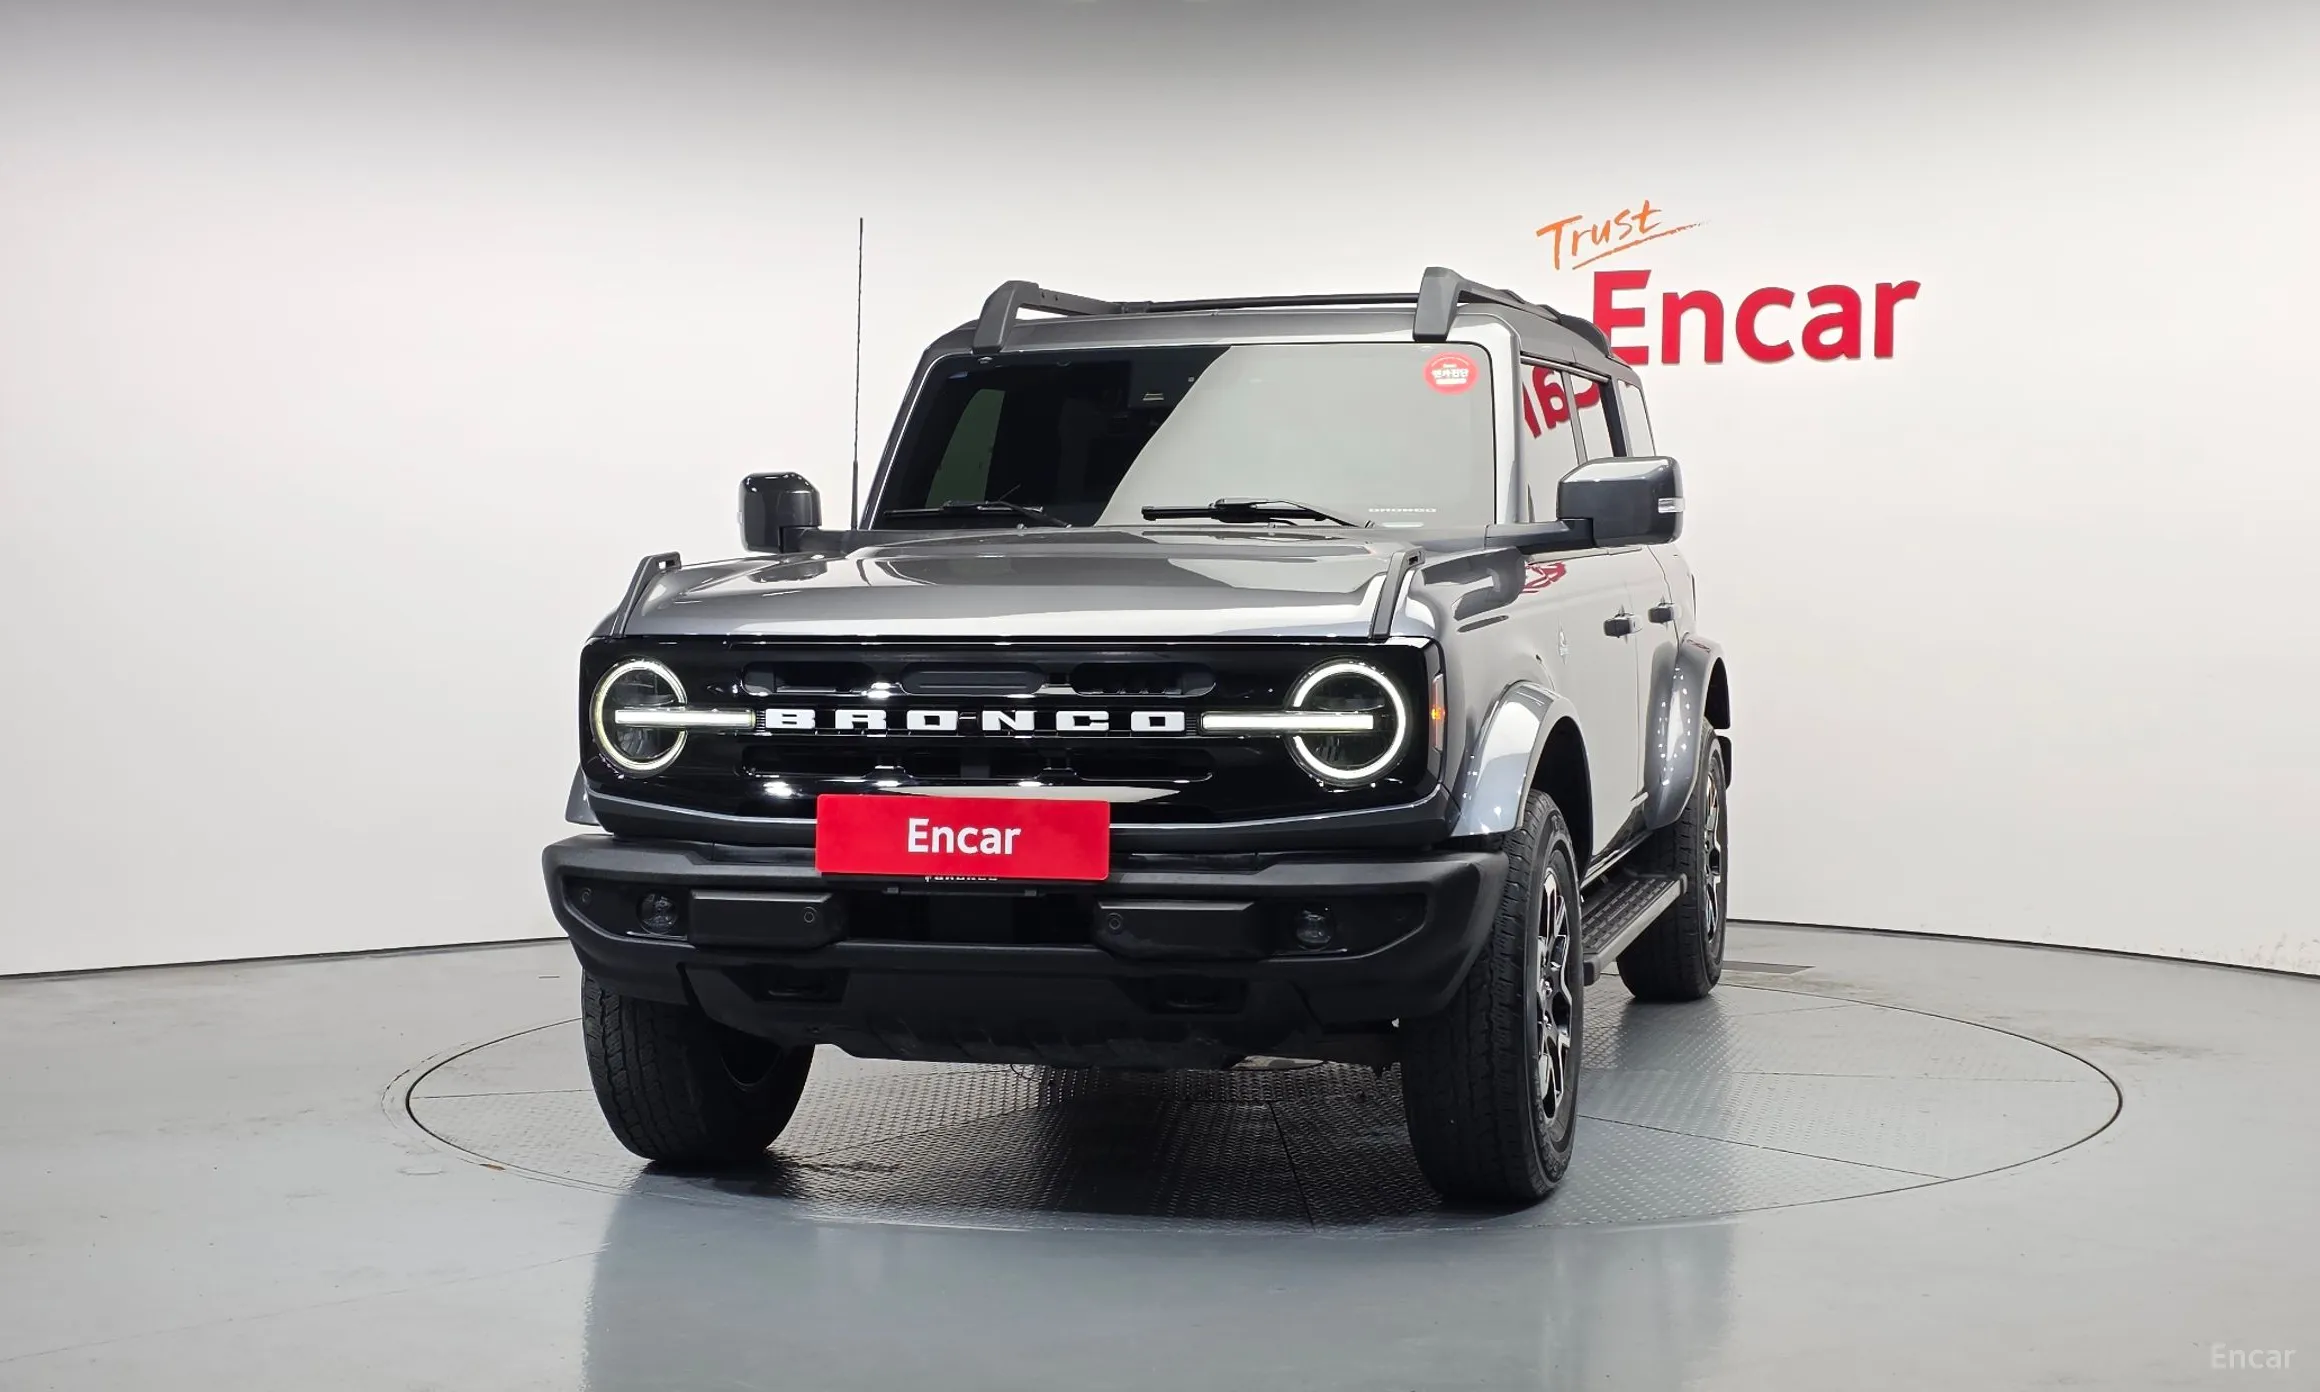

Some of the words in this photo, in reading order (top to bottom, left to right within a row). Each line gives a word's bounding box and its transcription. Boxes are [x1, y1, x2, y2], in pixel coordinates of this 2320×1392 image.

[1535, 200, 1662, 270] Trust
[1593, 269, 1921, 366] Encar
[764, 708, 1186, 732] BRONCO
[906, 818, 1022, 855] Encar
